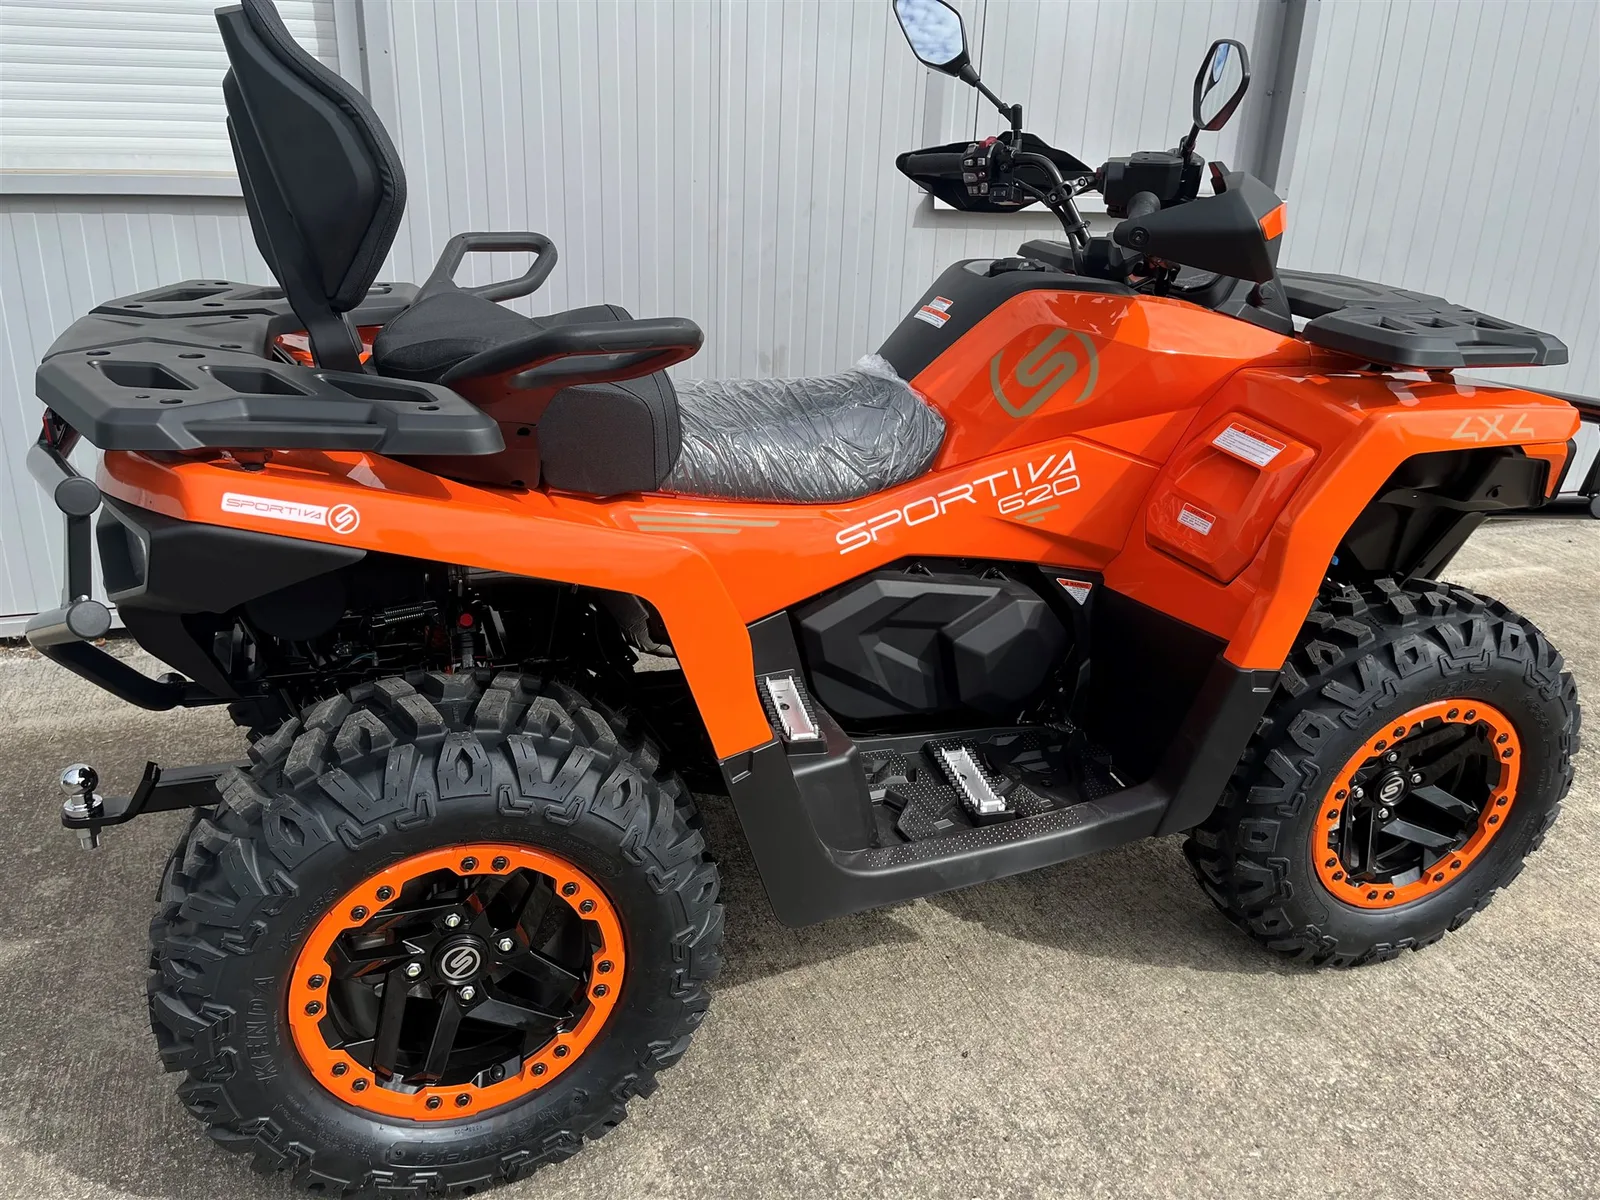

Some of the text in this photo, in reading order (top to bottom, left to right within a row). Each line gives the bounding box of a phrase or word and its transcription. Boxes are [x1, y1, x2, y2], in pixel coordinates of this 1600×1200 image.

[1451, 412, 1535, 442] 4X4
[225, 497, 323, 520] SPORTIVA
[835, 449, 1077, 555] SPORTIVA
[997, 474, 1081, 515] 620
[246, 975, 279, 1081] KENDA
